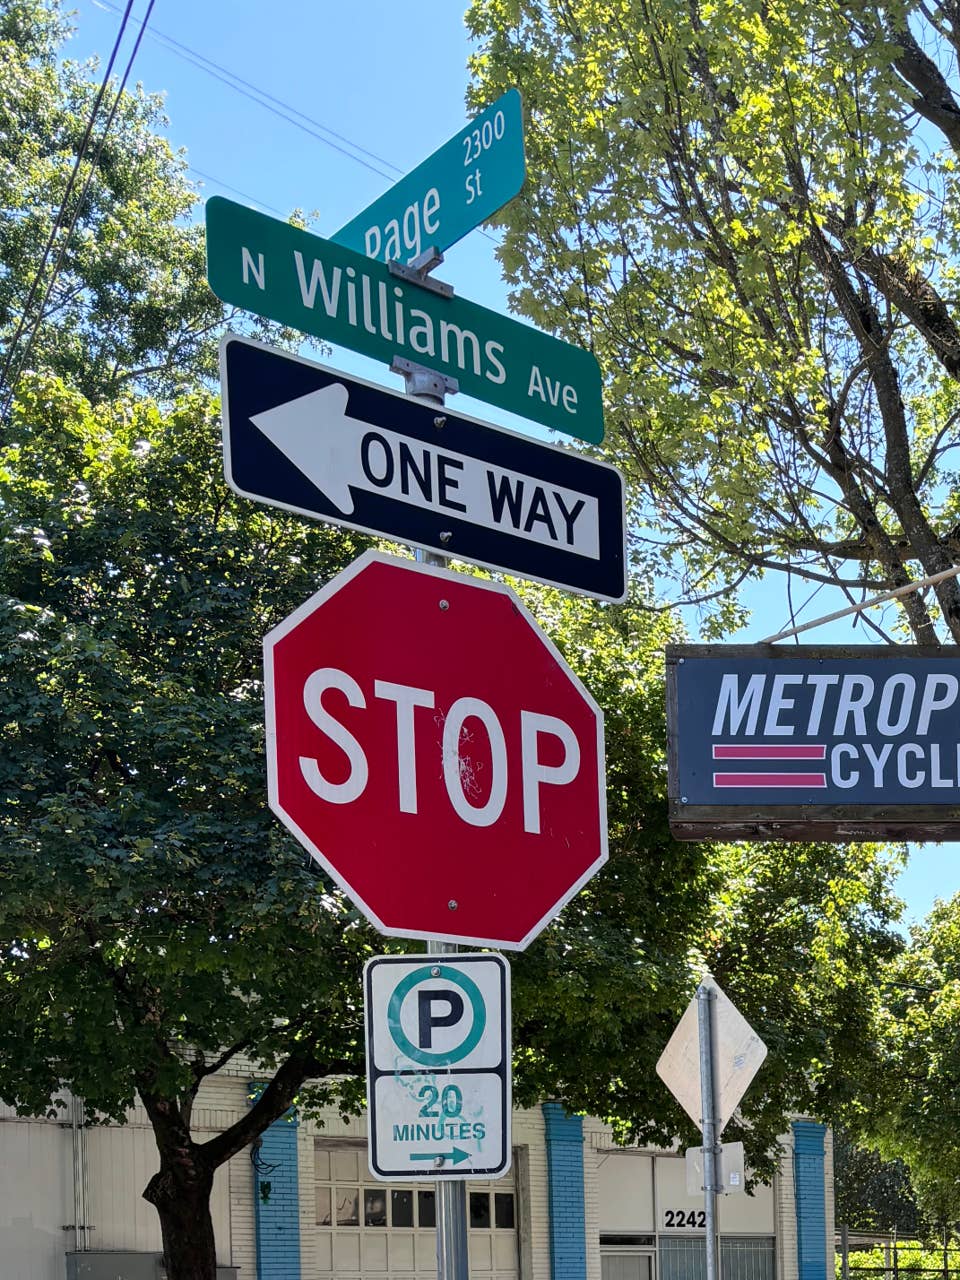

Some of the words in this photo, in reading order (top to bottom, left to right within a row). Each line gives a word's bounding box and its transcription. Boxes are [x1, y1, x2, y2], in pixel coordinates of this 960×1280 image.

[463, 110, 505, 167] 2300
[365, 187, 441, 265] Page
[465, 168, 484, 205] St
[242, 247, 266, 290] N
[293, 249, 507, 385] Williams
[527, 365, 578, 414] Ave
[361, 431, 467, 514] ONE
[486, 470, 586, 546] WAY
[299, 667, 581, 834] STOP
[417, 989, 465, 1049] P
[418, 1084, 463, 1118] 20
[393, 1122, 486, 1142] MINUTES
[665, 1210, 707, 1228] 2242
